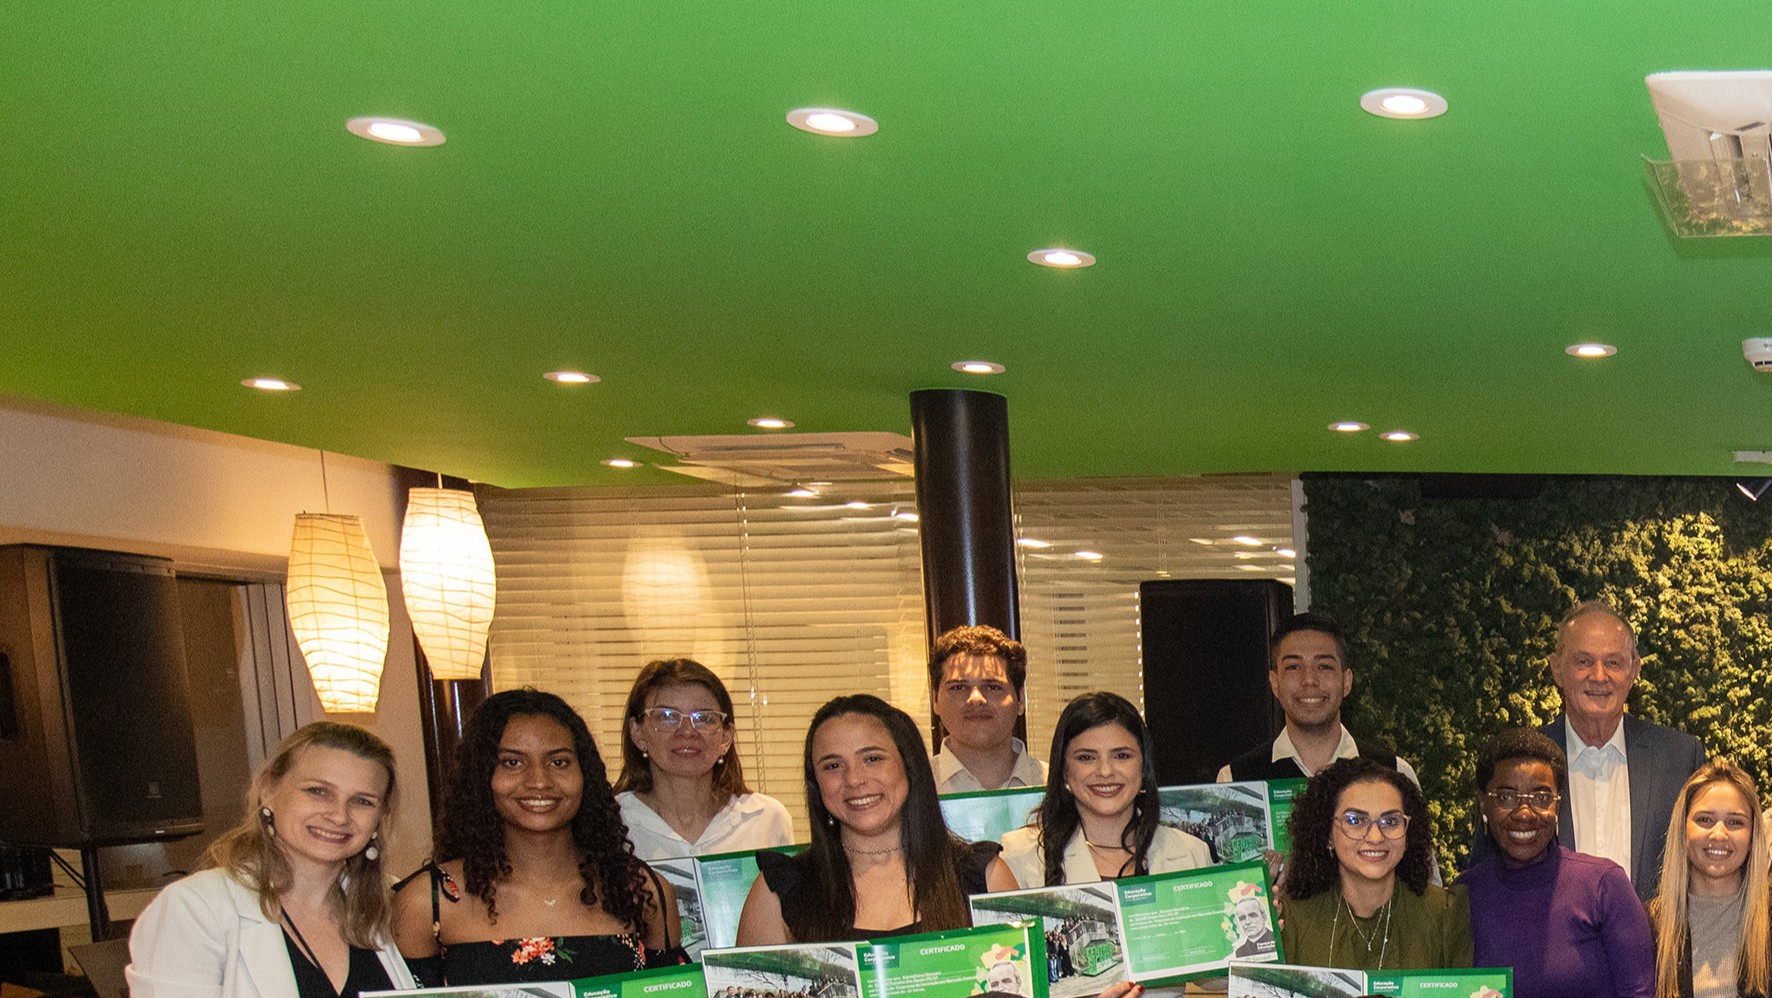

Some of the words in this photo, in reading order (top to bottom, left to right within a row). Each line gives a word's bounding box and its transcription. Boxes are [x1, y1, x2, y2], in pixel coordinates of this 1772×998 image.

[1173, 881, 1213, 892] CERTIFICADO
[920, 944, 965, 956] CERTIFICADO
[644, 980, 692, 993] CERTIFICADO
